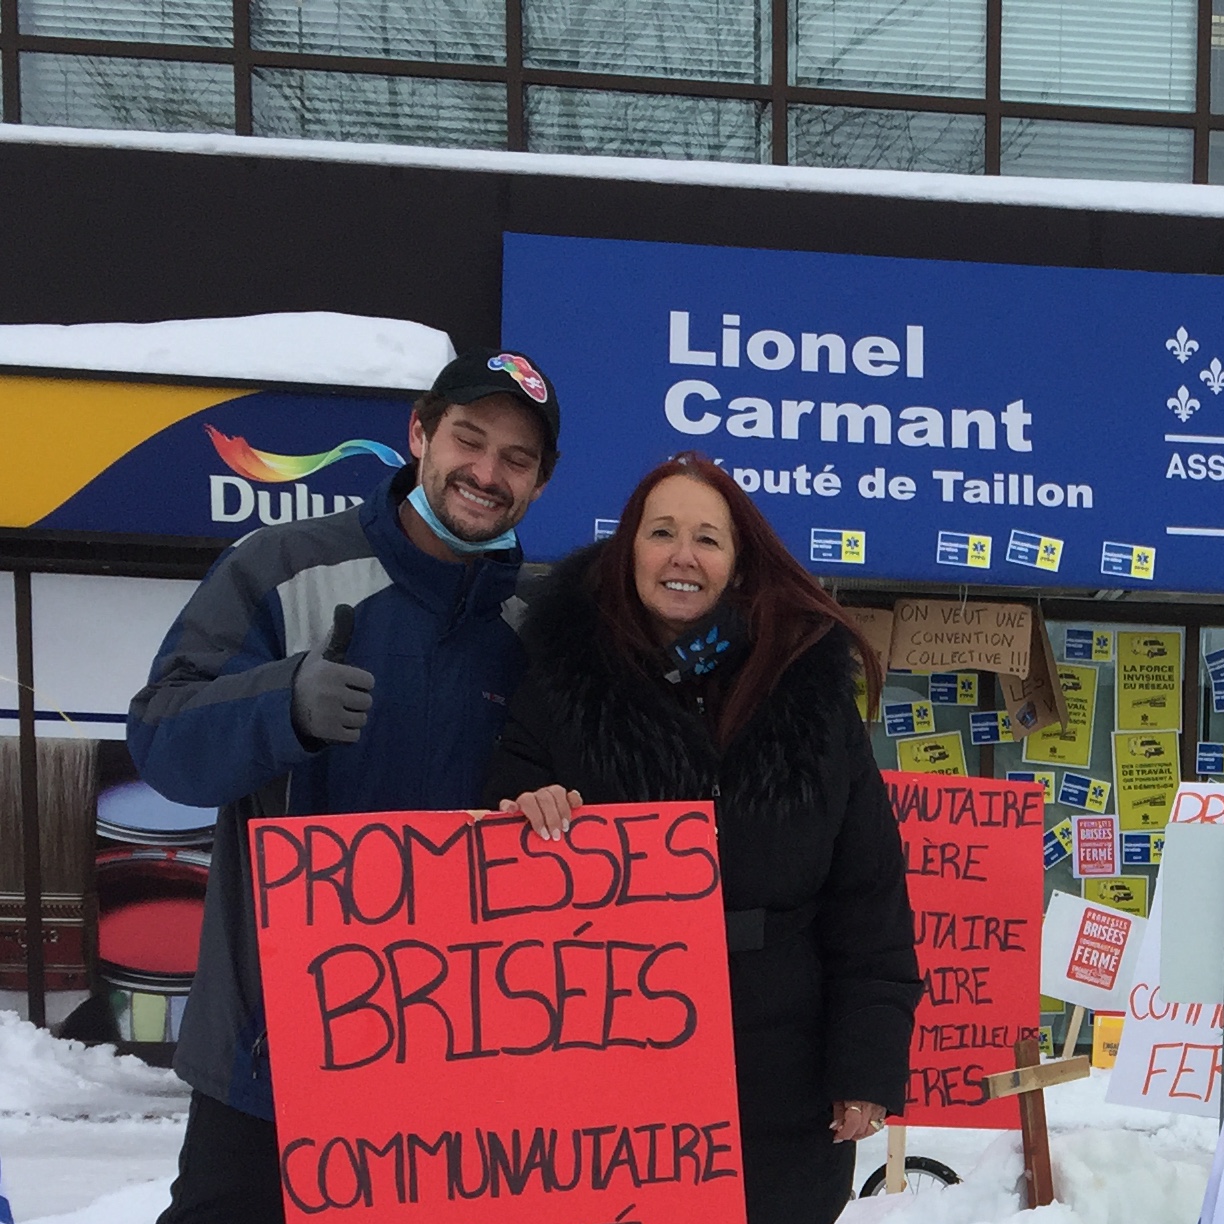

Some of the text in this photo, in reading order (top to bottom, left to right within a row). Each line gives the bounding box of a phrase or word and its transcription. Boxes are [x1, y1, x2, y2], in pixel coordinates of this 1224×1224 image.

[669, 311, 924, 379] Lionel
[664, 379, 1033, 453] Carmant
[209, 475, 365, 526] Dulu
[858, 467, 917, 501] de
[933, 470, 1094, 508] Taillon
[901, 604, 1028, 629] ON VEUT UNE
[905, 648, 1001, 667] COLLECTIVE
[910, 630, 1015, 649] CONVENTION
[1123, 665, 1175, 673] LA FORCE
[1123, 673, 1175, 682] INVISIBLE
[1122, 768, 1173, 777] DE TRAVAIL
[884, 782, 1042, 829] NAUTAIRE
[254, 811, 719, 929] PROMESSES
[307, 921, 696, 1071] BRISÉES
[281, 1120, 738, 1213] COMMUNAUTAIRE
